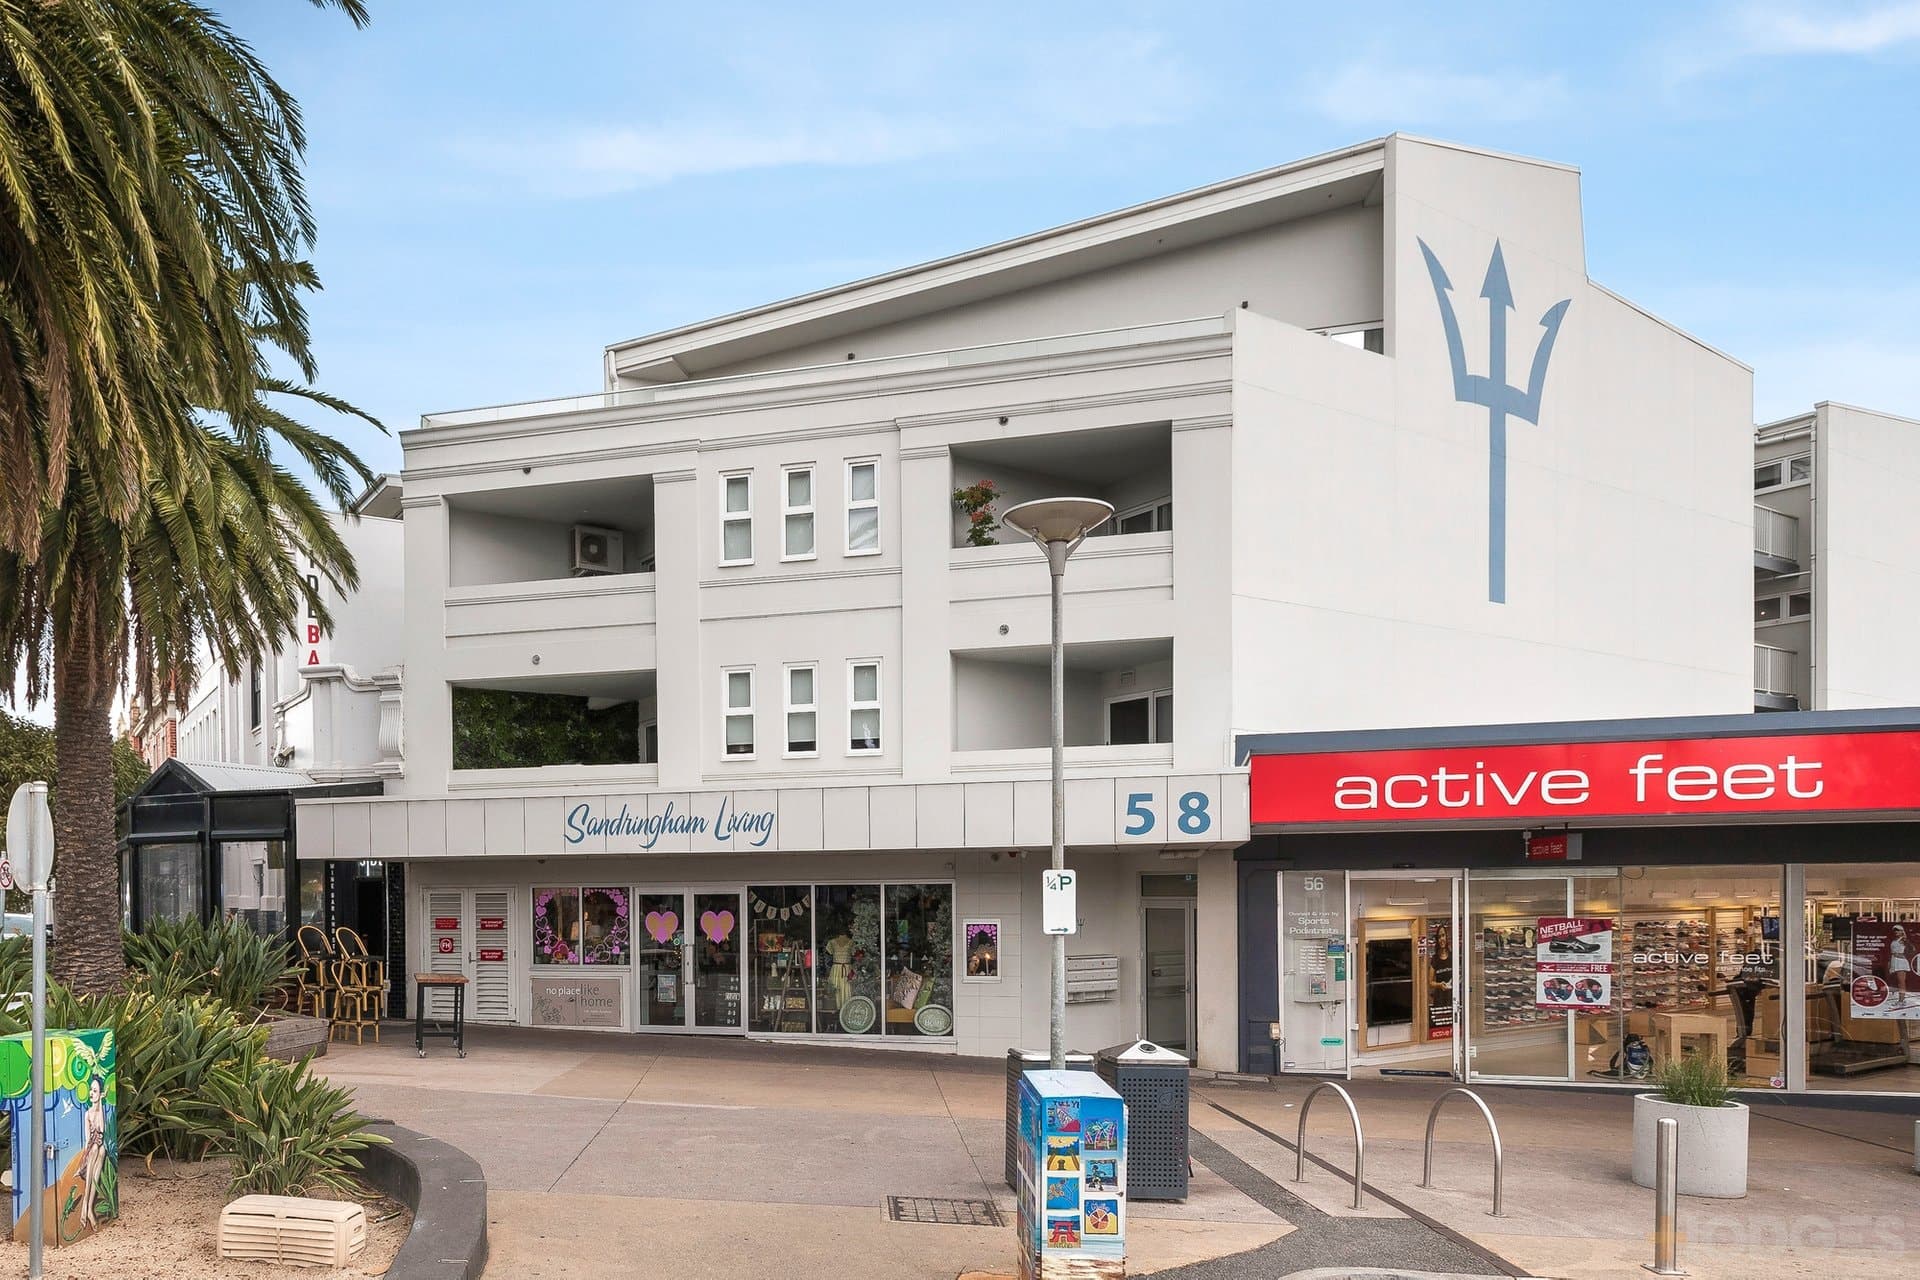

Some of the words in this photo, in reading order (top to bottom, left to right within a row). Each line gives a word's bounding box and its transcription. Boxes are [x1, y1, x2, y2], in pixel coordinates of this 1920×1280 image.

[1334, 762, 1590, 810] active
[1629, 754, 1824, 802] feet
[564, 801, 710, 849] Sandringham
[714, 795, 775, 847] Living
[1304, 877, 1324, 891] 56
[1298, 917, 1330, 926] Sports
[1540, 920, 1585, 935] NETBALL
[1289, 927, 1339, 935] Podiatrists
[1633, 950, 1709, 964] active
[1720, 950, 1774, 965] feet
[1590, 965, 1609, 973] FREE
[546, 987, 557, 995] no
[558, 986, 580, 997] place
[580, 984, 600, 996] like
[580, 996, 614, 1008] home
